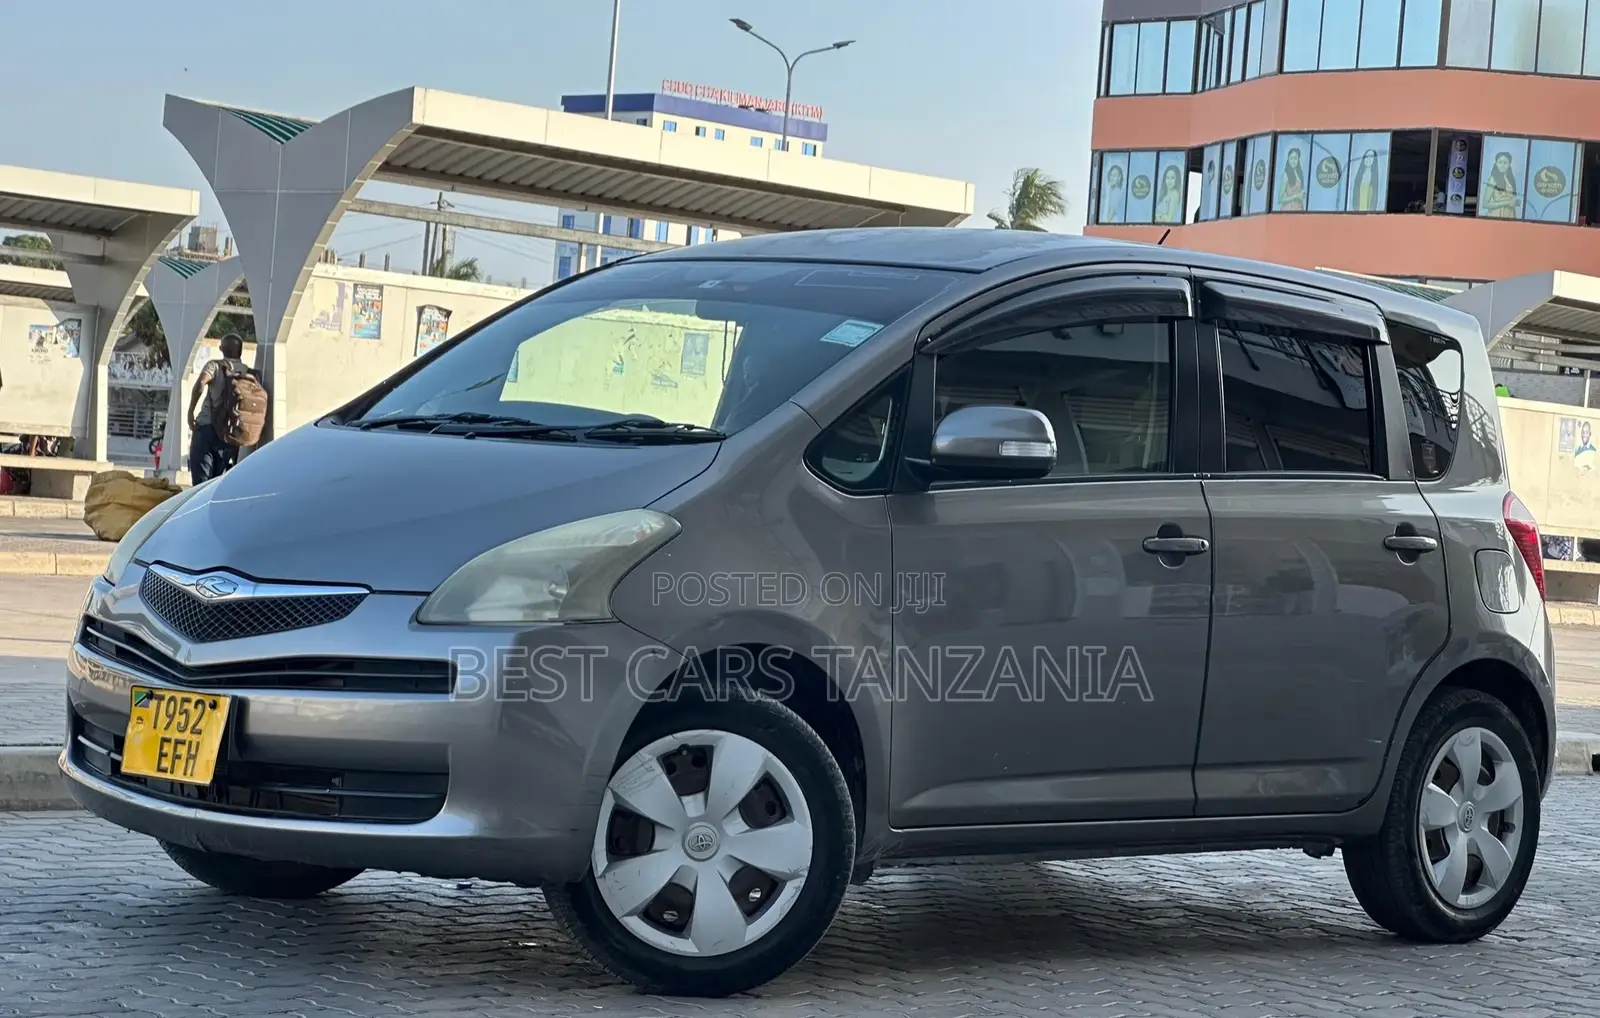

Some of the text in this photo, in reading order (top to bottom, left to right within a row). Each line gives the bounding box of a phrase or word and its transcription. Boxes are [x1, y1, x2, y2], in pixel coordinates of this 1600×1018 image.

[662, 79, 693, 95] CHUO
[152, 693, 206, 735] T952
[157, 736, 201, 776] EFH
